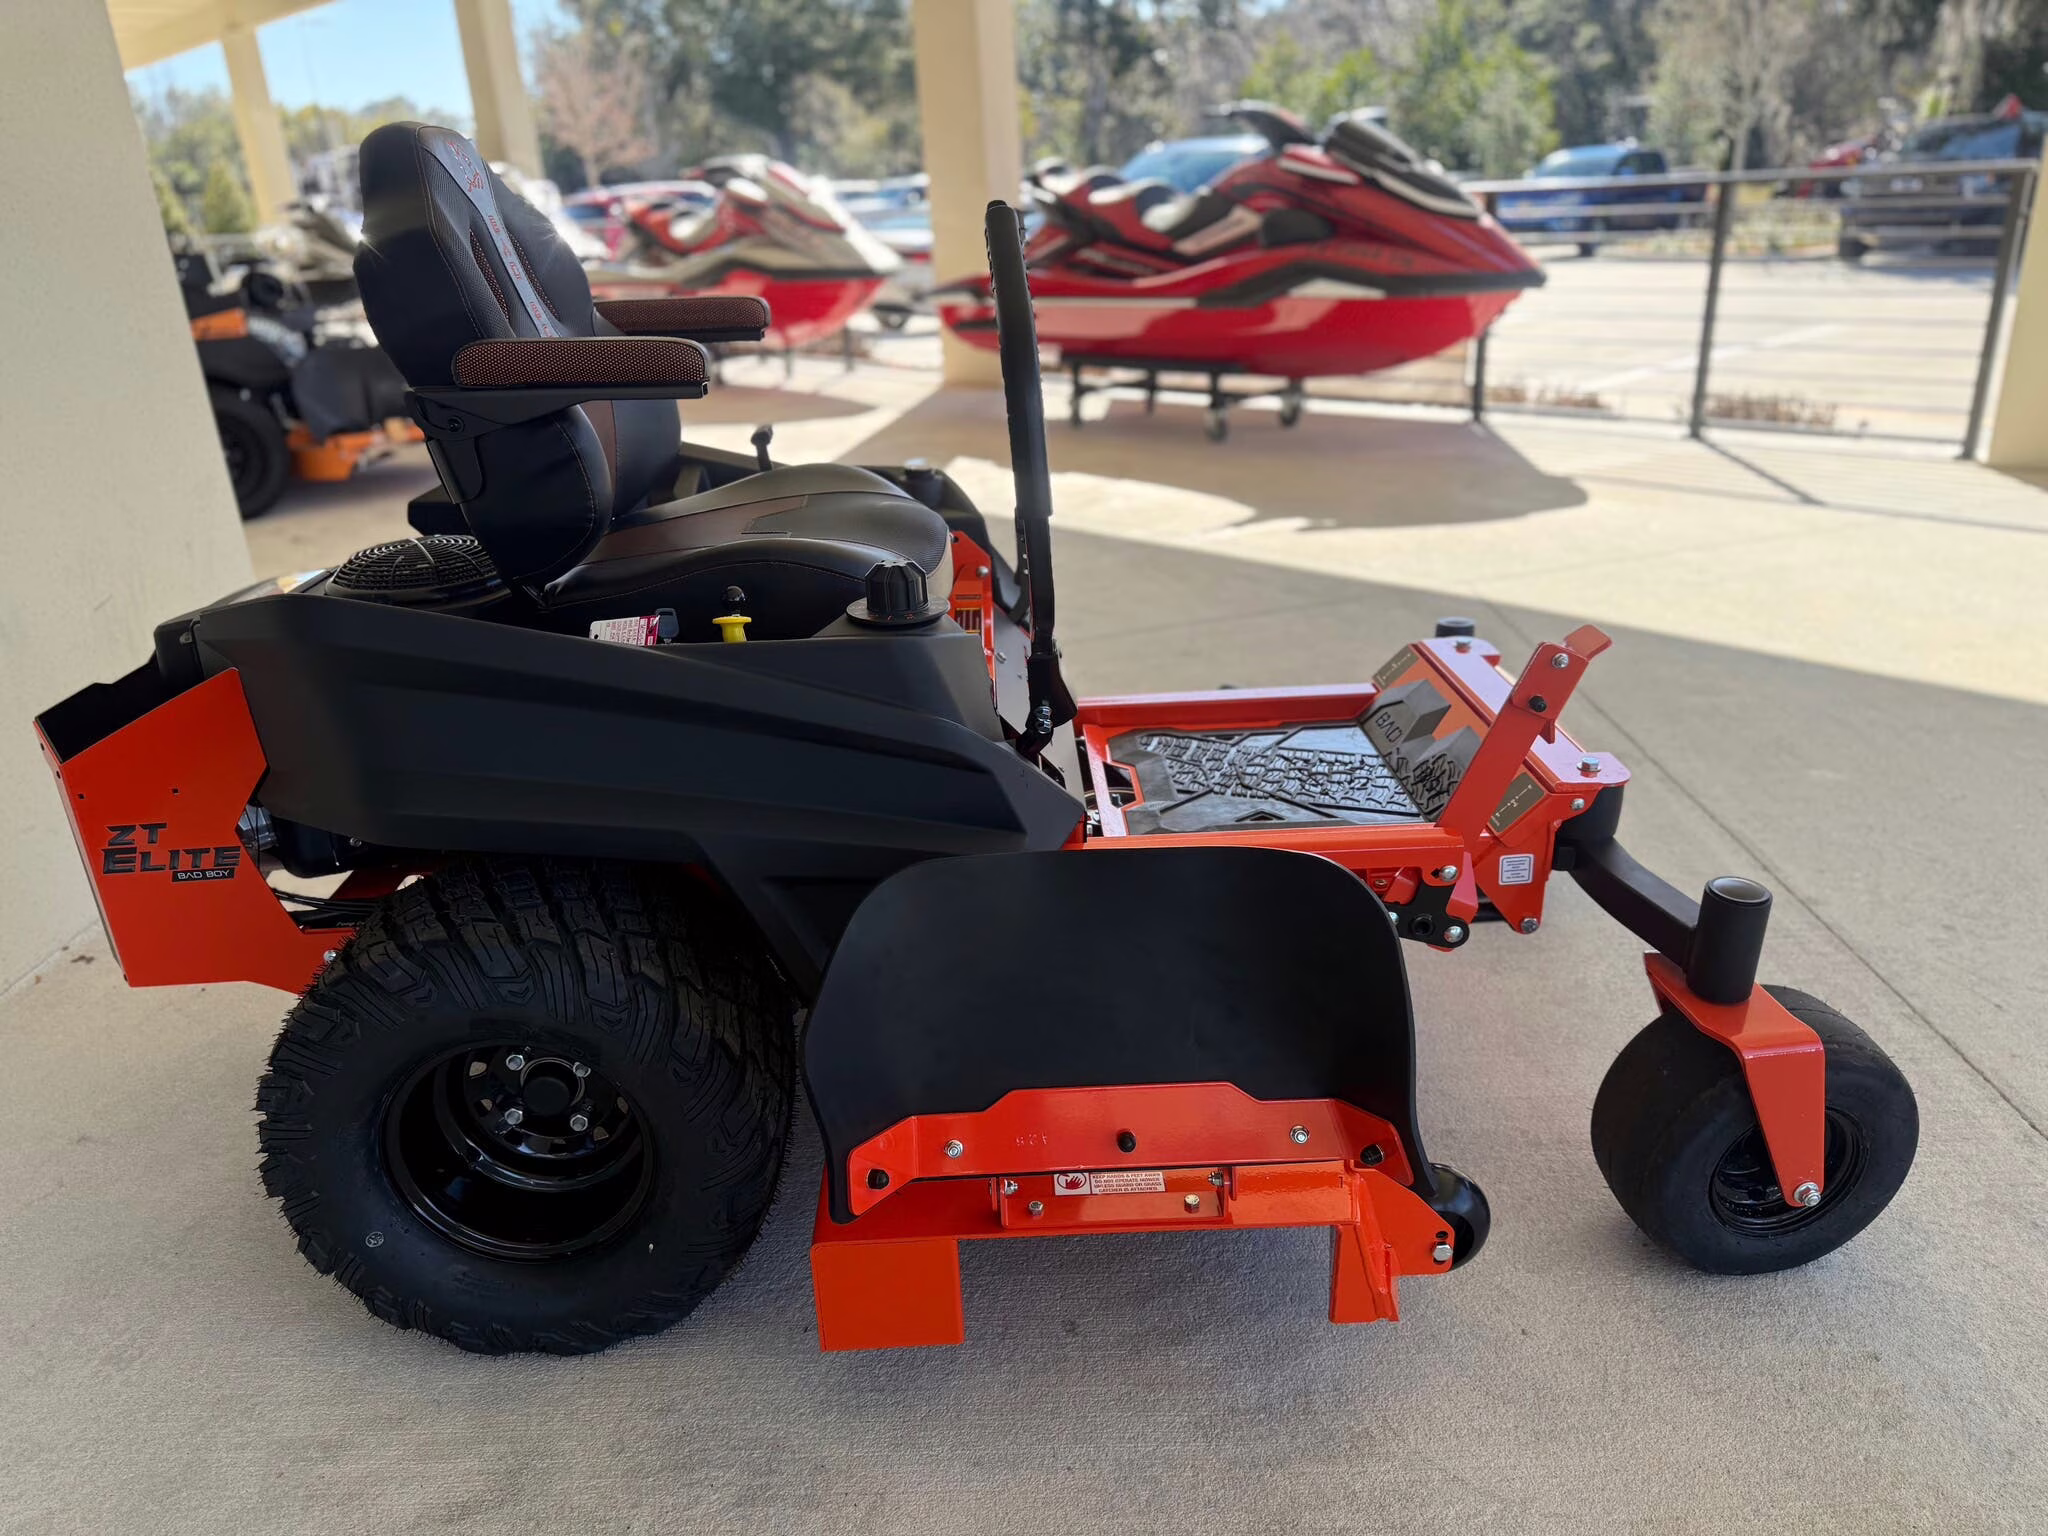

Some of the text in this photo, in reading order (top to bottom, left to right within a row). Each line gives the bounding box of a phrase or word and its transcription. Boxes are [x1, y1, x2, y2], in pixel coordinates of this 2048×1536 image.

[1376, 712, 1402, 742] BAD
[105, 822, 167, 846] ZT
[101, 846, 241, 874] ELITE
[177, 869, 231, 880] BAD BOY
